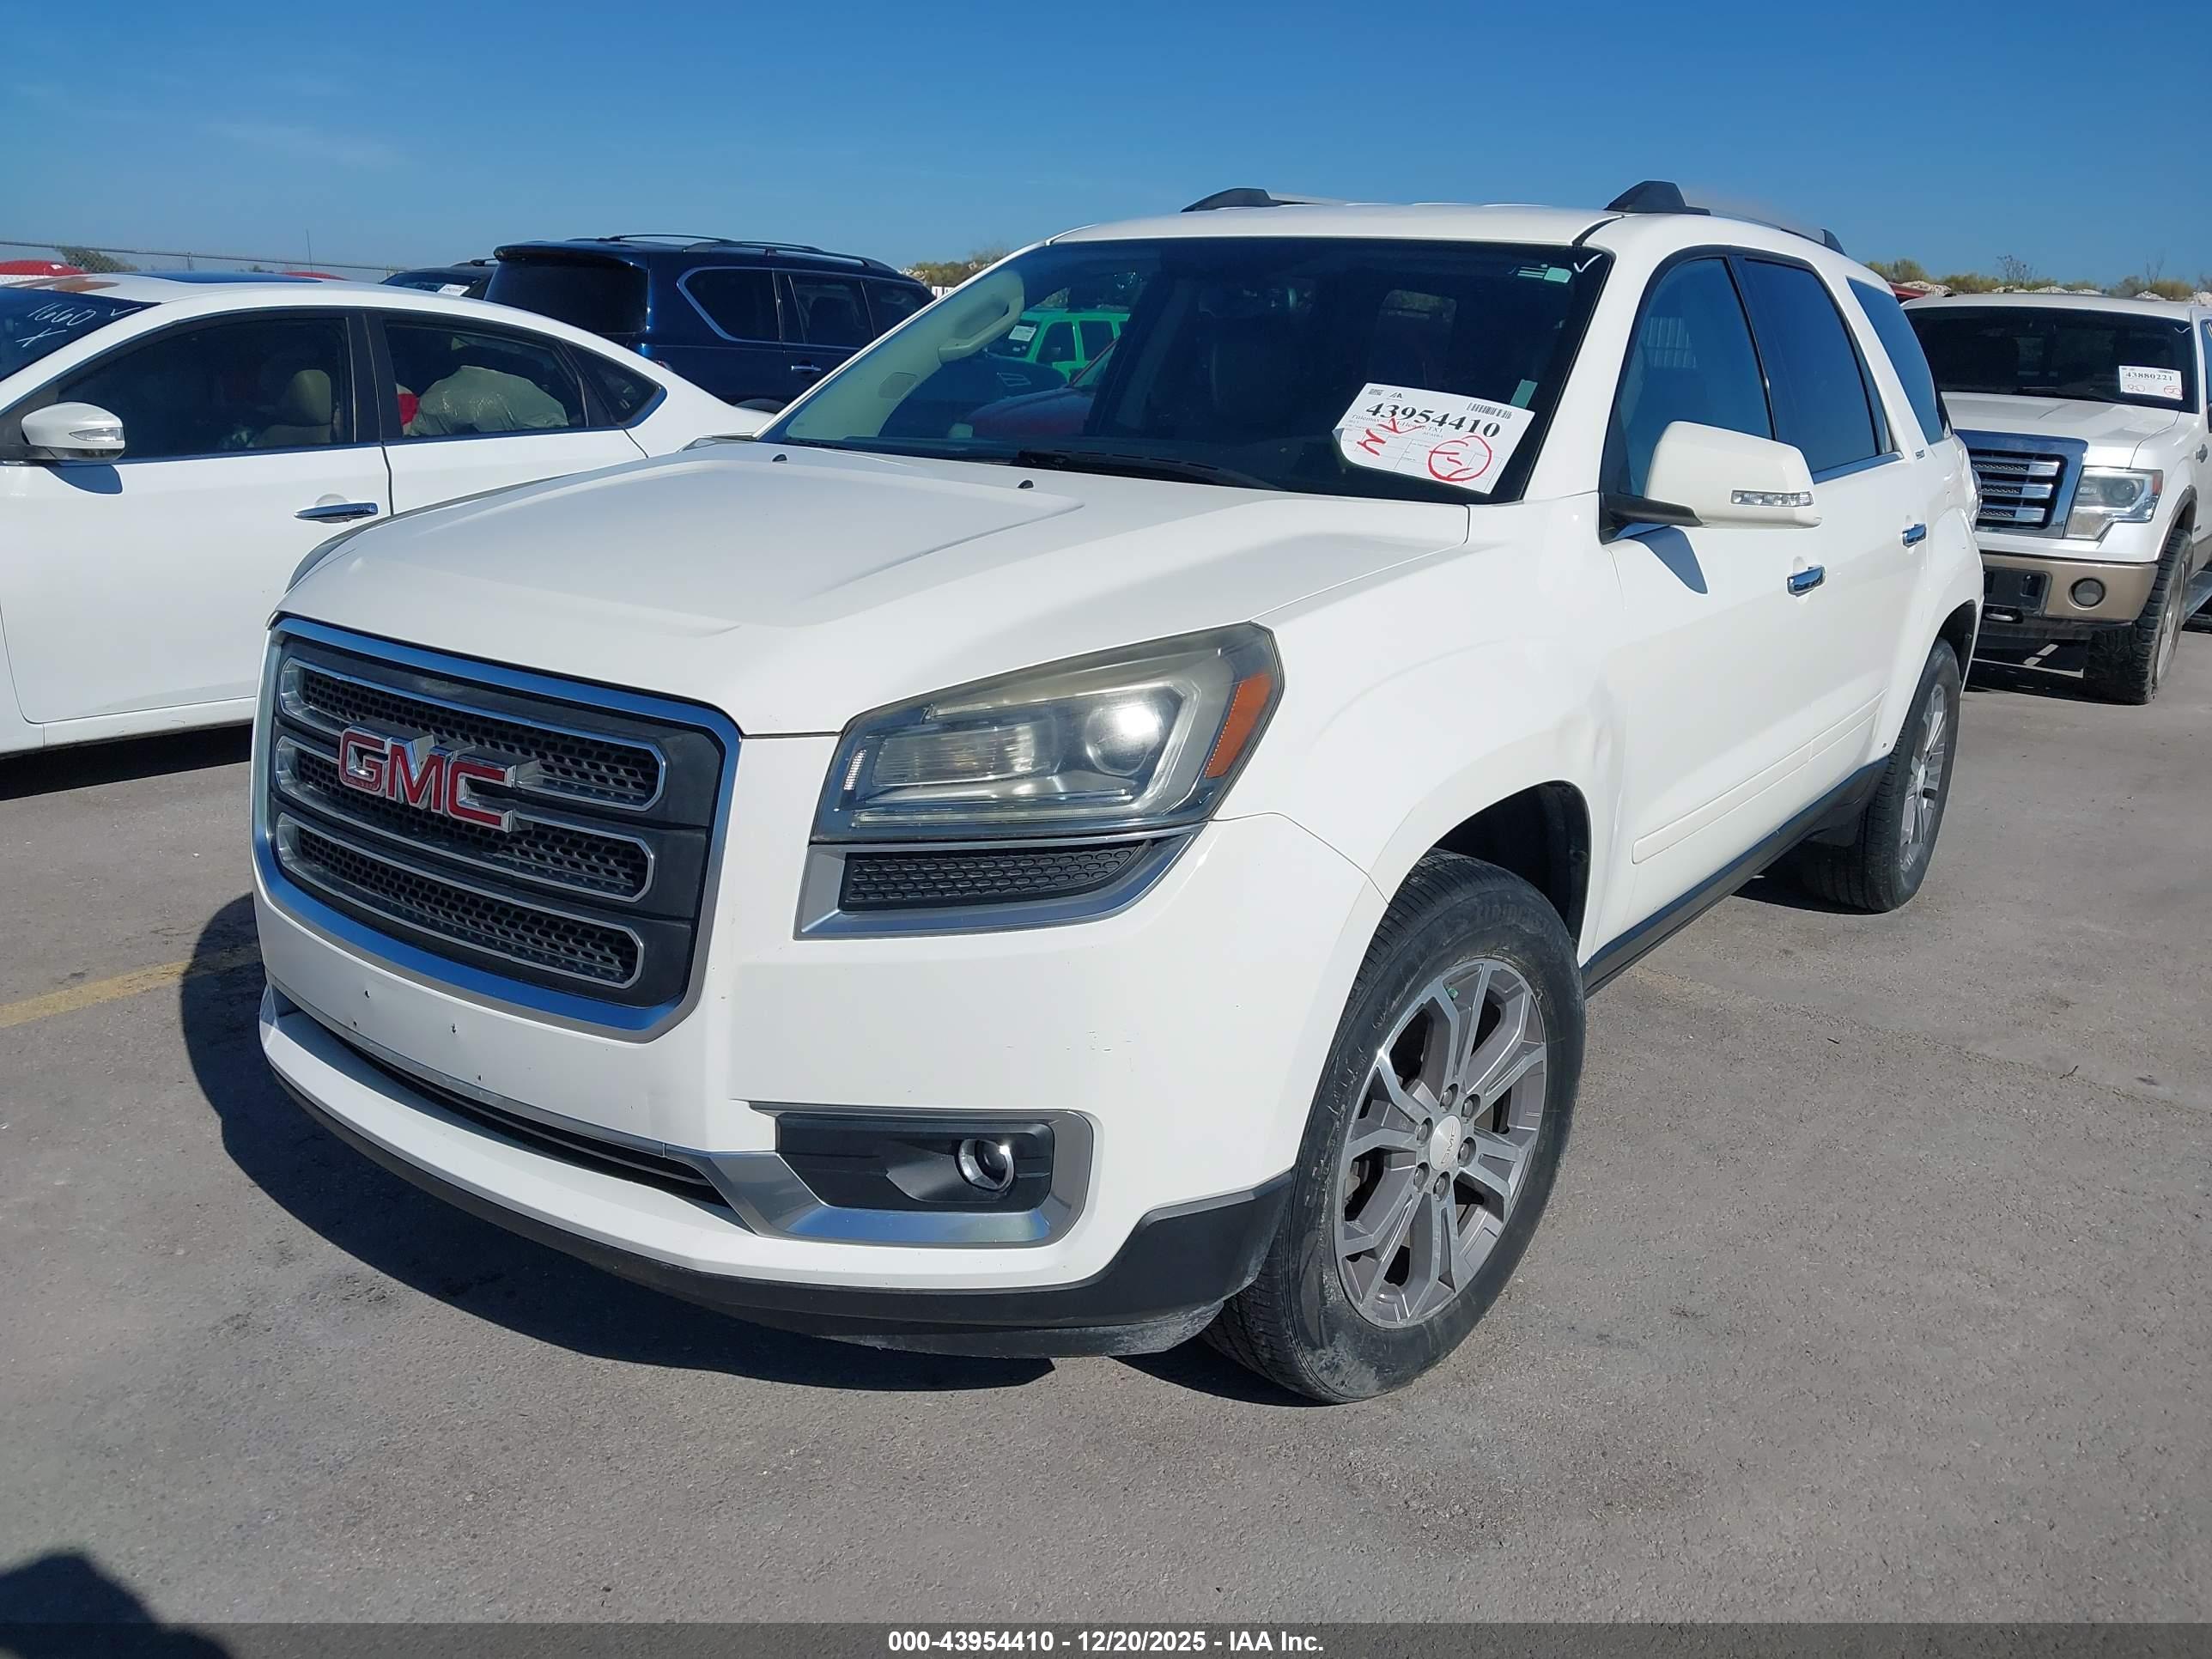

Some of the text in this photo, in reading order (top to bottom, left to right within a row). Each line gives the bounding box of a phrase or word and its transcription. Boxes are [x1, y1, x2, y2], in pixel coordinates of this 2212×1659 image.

[2125, 371, 2173, 382] 43880221
[1364, 402, 1502, 439] 43954410
[338, 726, 519, 833] GMC
